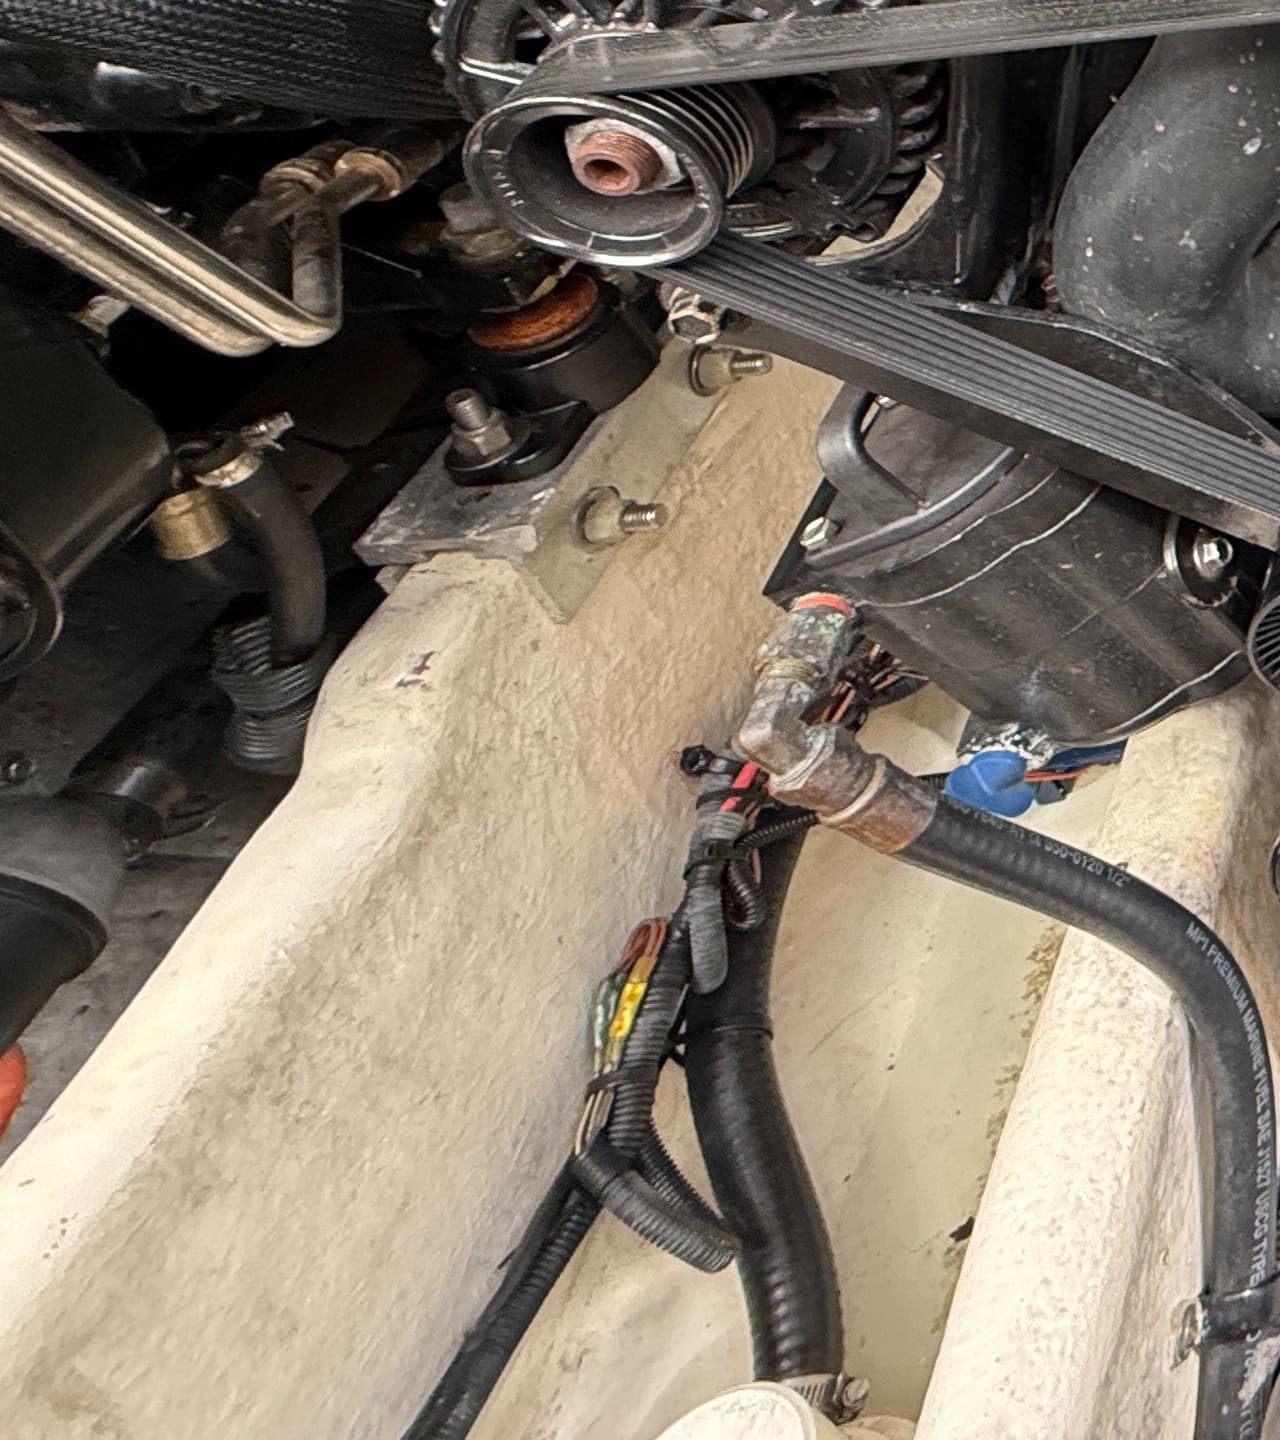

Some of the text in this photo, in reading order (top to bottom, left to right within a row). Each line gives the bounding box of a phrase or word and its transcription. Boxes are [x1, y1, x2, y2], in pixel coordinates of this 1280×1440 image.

[1185, 921, 1272, 1288] MPI PREMIUM MARINE FUEL SAE J1527 USCG TYPE
